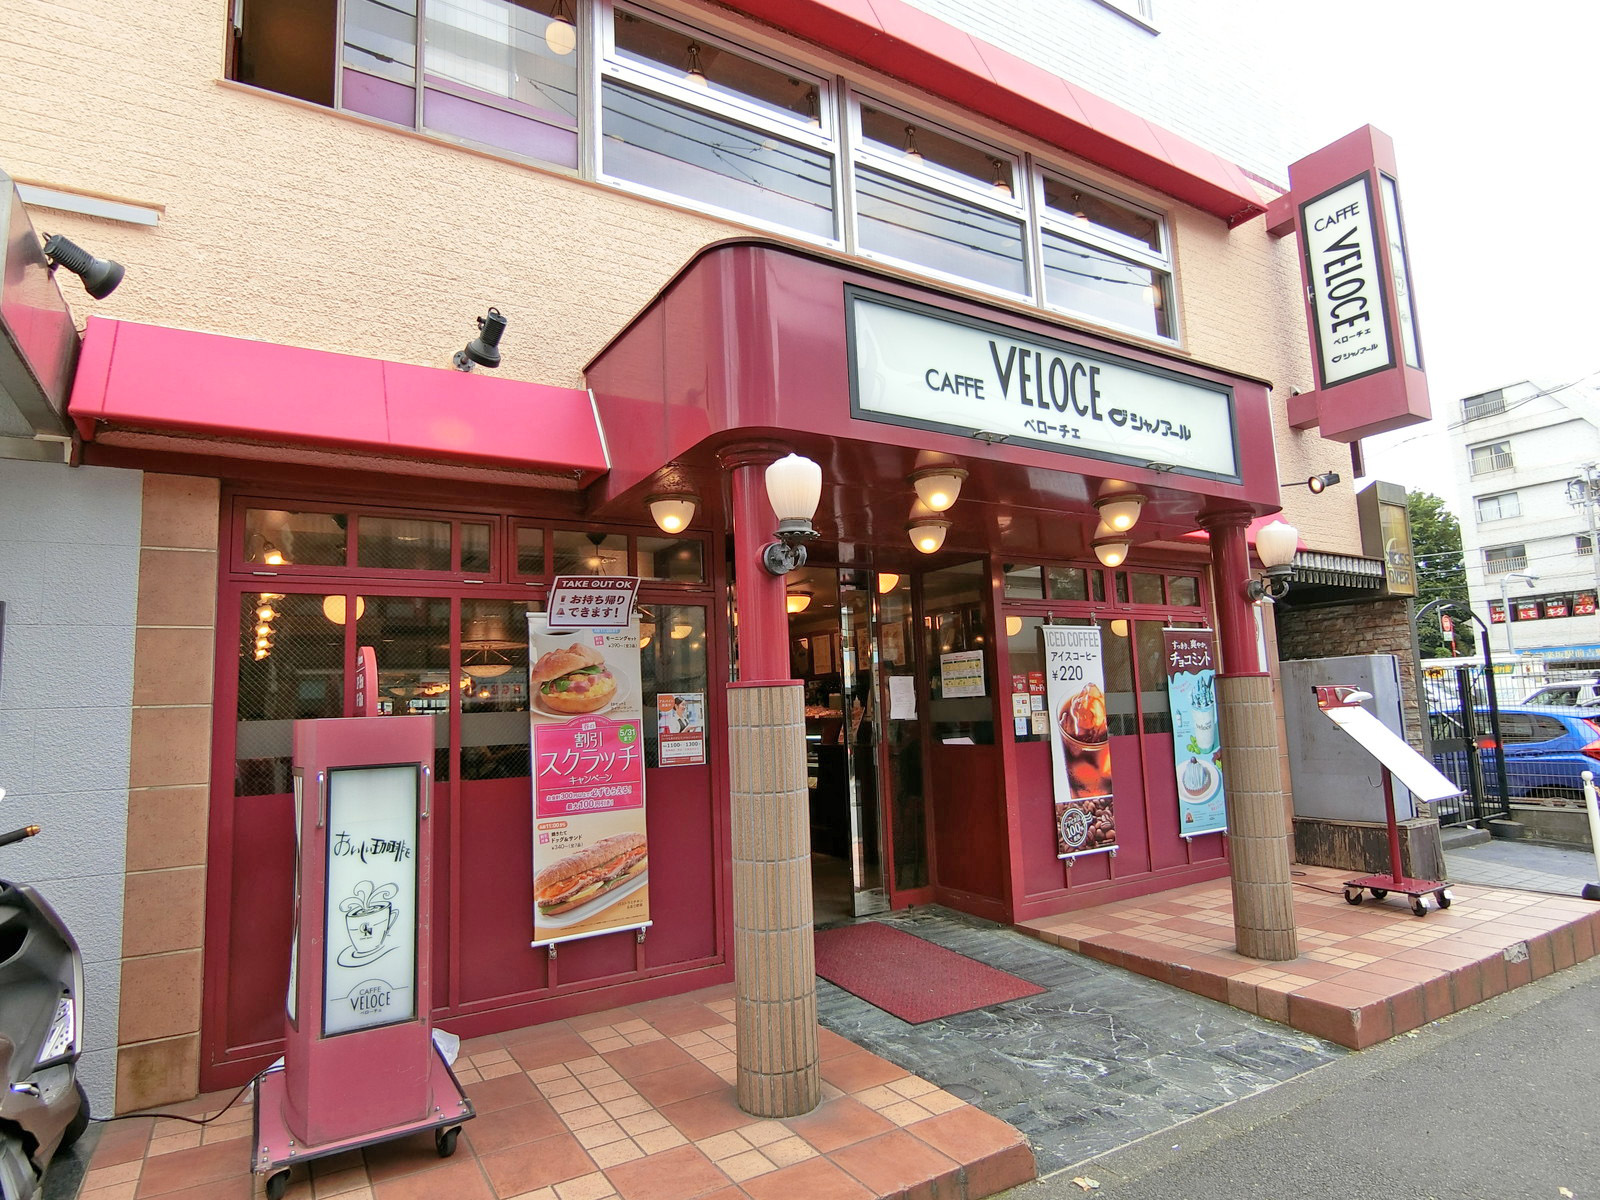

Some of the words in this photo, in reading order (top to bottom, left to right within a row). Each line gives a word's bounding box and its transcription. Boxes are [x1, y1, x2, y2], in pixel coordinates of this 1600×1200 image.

[1313, 201, 1360, 232] CAFFE
[1323, 226, 1370, 333] VELOCE
[1333, 328, 1371, 344] ベローチェ
[1343, 344, 1378, 360] シャノアール
[925, 368, 985, 400] CAFFE
[988, 340, 1103, 421] VELOCE
[1024, 420, 1081, 439] ベローチェ
[1130, 413, 1191, 441] シャノアール
[562, 580, 589, 588] TAKE
[591, 580, 614, 588] OUT
[570, 595, 625, 605] お持ち帰り
[1046, 632, 1066, 647] ICED
[1067, 632, 1099, 647] COFFEE
[1051, 651, 1097, 662] アイスコーヒー
[1170, 651, 1211, 668] チョコミント
[1052, 665, 1083, 681] ¥220
[574, 731, 603, 748] 割引
[620, 728, 636, 737] 5/31
[540, 745, 639, 777] スクラッチ
[569, 773, 613, 785] キャンペーン
[334, 830, 410, 864] おいしい珈琲を
[359, 986, 382, 996] CAFFE
[350, 992, 391, 1011] VELOCE
